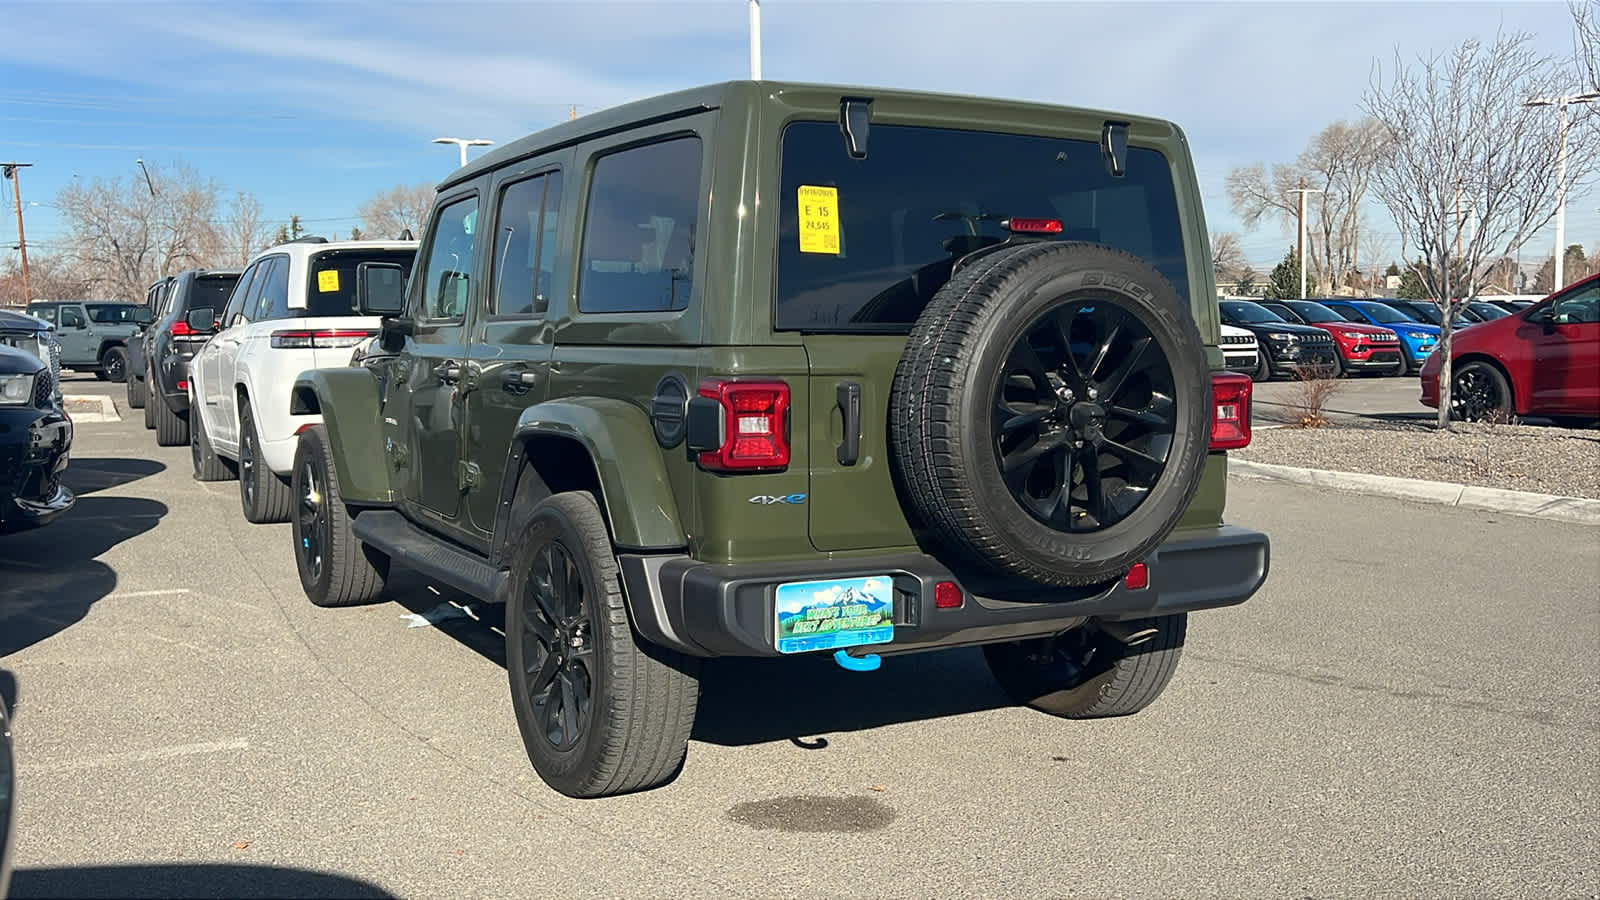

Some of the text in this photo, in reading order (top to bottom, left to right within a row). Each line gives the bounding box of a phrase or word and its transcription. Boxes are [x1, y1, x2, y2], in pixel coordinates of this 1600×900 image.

[819, 206, 829, 217] 15
[841, 604, 867, 617] YOUR
[792, 614, 881, 634] NEXT ADVENTURE?
